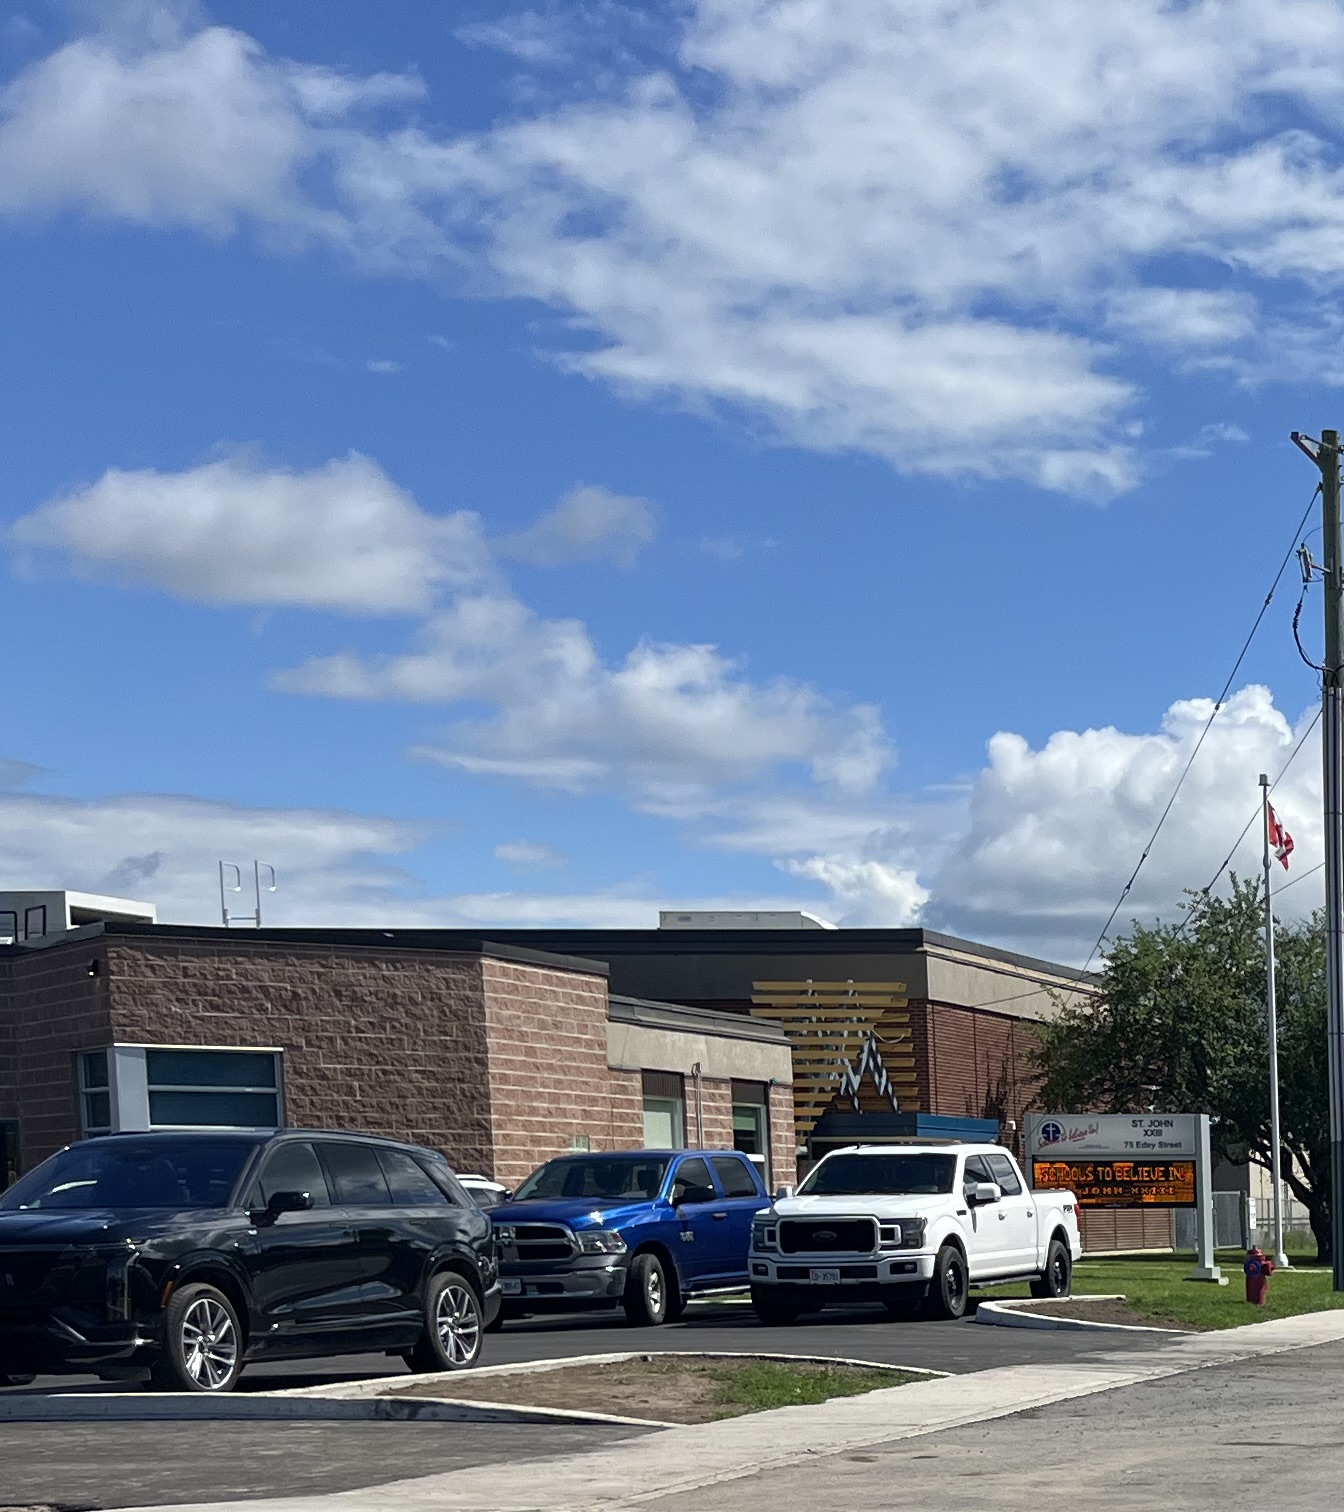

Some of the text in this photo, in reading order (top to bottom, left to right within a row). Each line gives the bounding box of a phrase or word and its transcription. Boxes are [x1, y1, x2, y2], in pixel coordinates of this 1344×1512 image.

[1131, 1119, 1174, 1128] ST. JOHN
[1143, 1129, 1163, 1137] XXIII
[1124, 1141, 1182, 1151] 75 Edey Street
[1041, 1167, 1094, 1181] SCHOOLS
[1097, 1167, 1112, 1180] TO
[1115, 1167, 1165, 1181] BELIEVE
